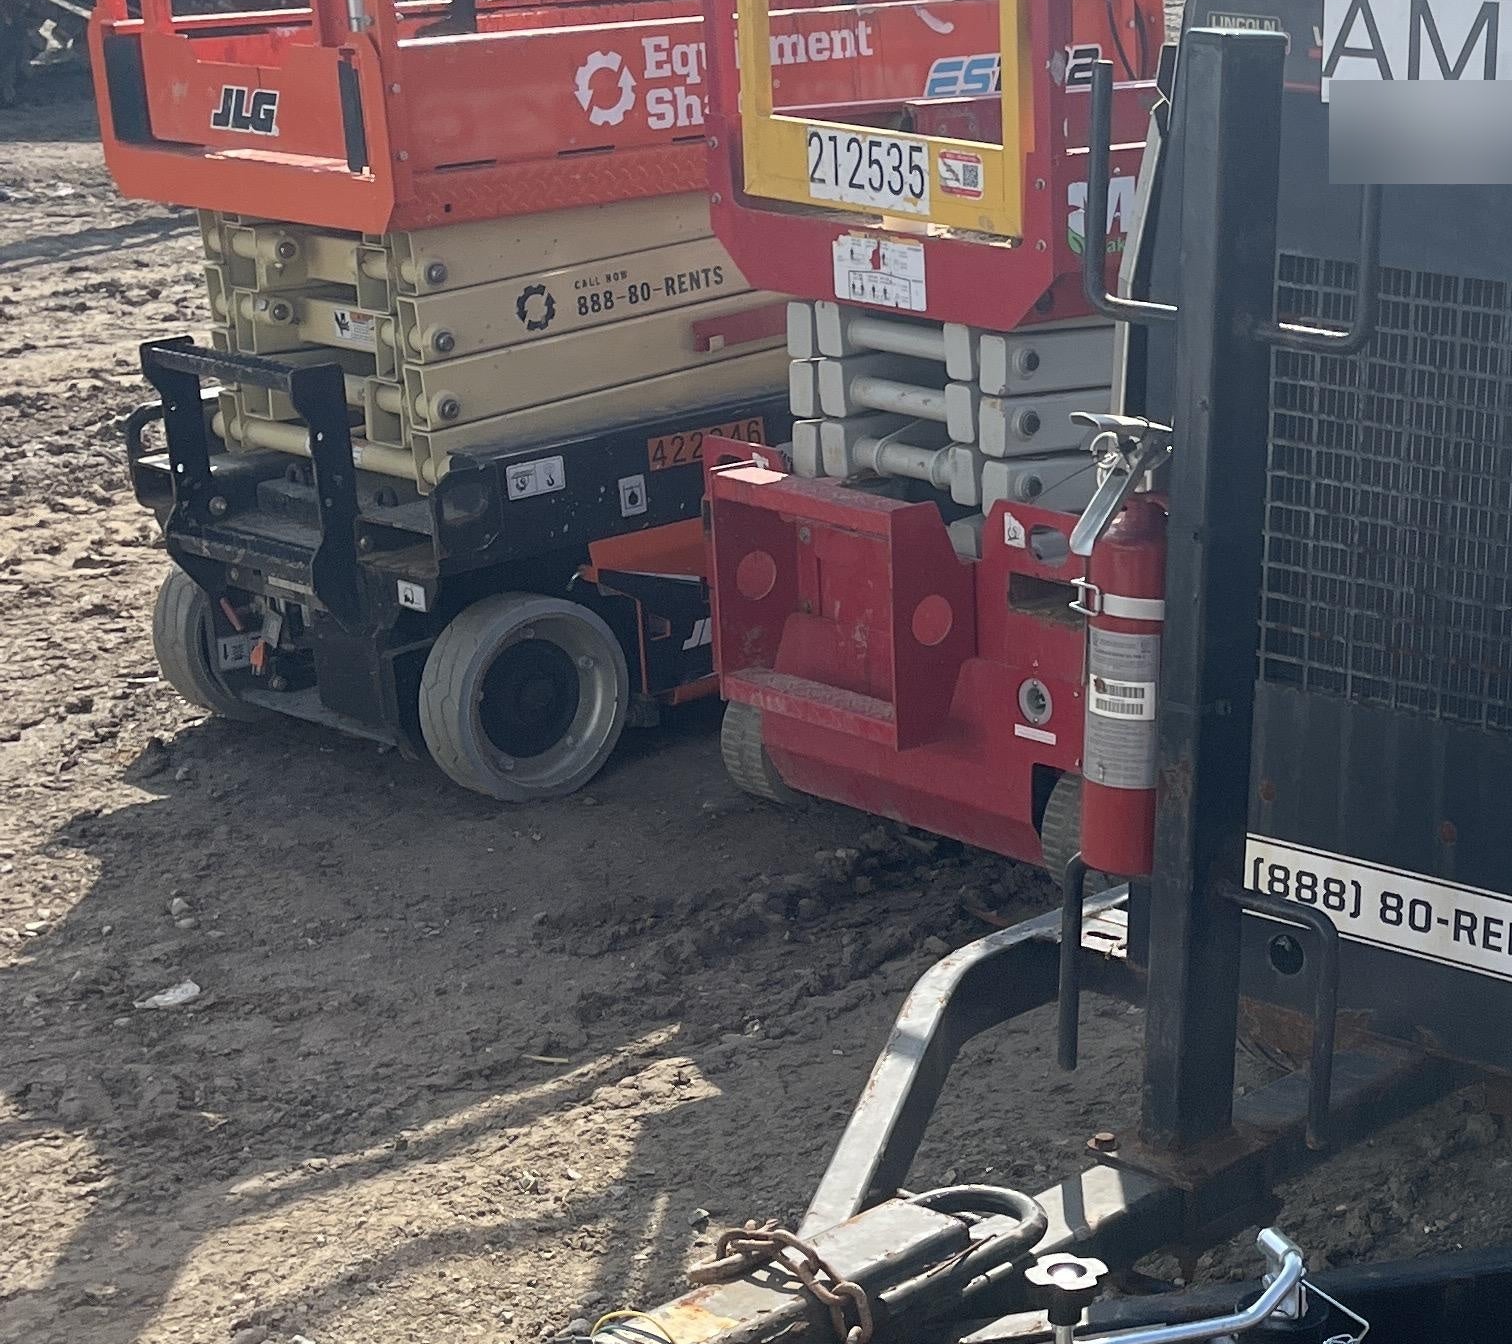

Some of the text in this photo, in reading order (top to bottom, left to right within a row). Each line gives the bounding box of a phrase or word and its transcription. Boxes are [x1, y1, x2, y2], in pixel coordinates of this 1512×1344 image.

[211, 84, 280, 136] JLG
[808, 131, 925, 199] 212535
[574, 276, 600, 290] CALL
[577, 266, 724, 316] 888-80-RENTS
[1253, 857, 1362, 919] (888)
